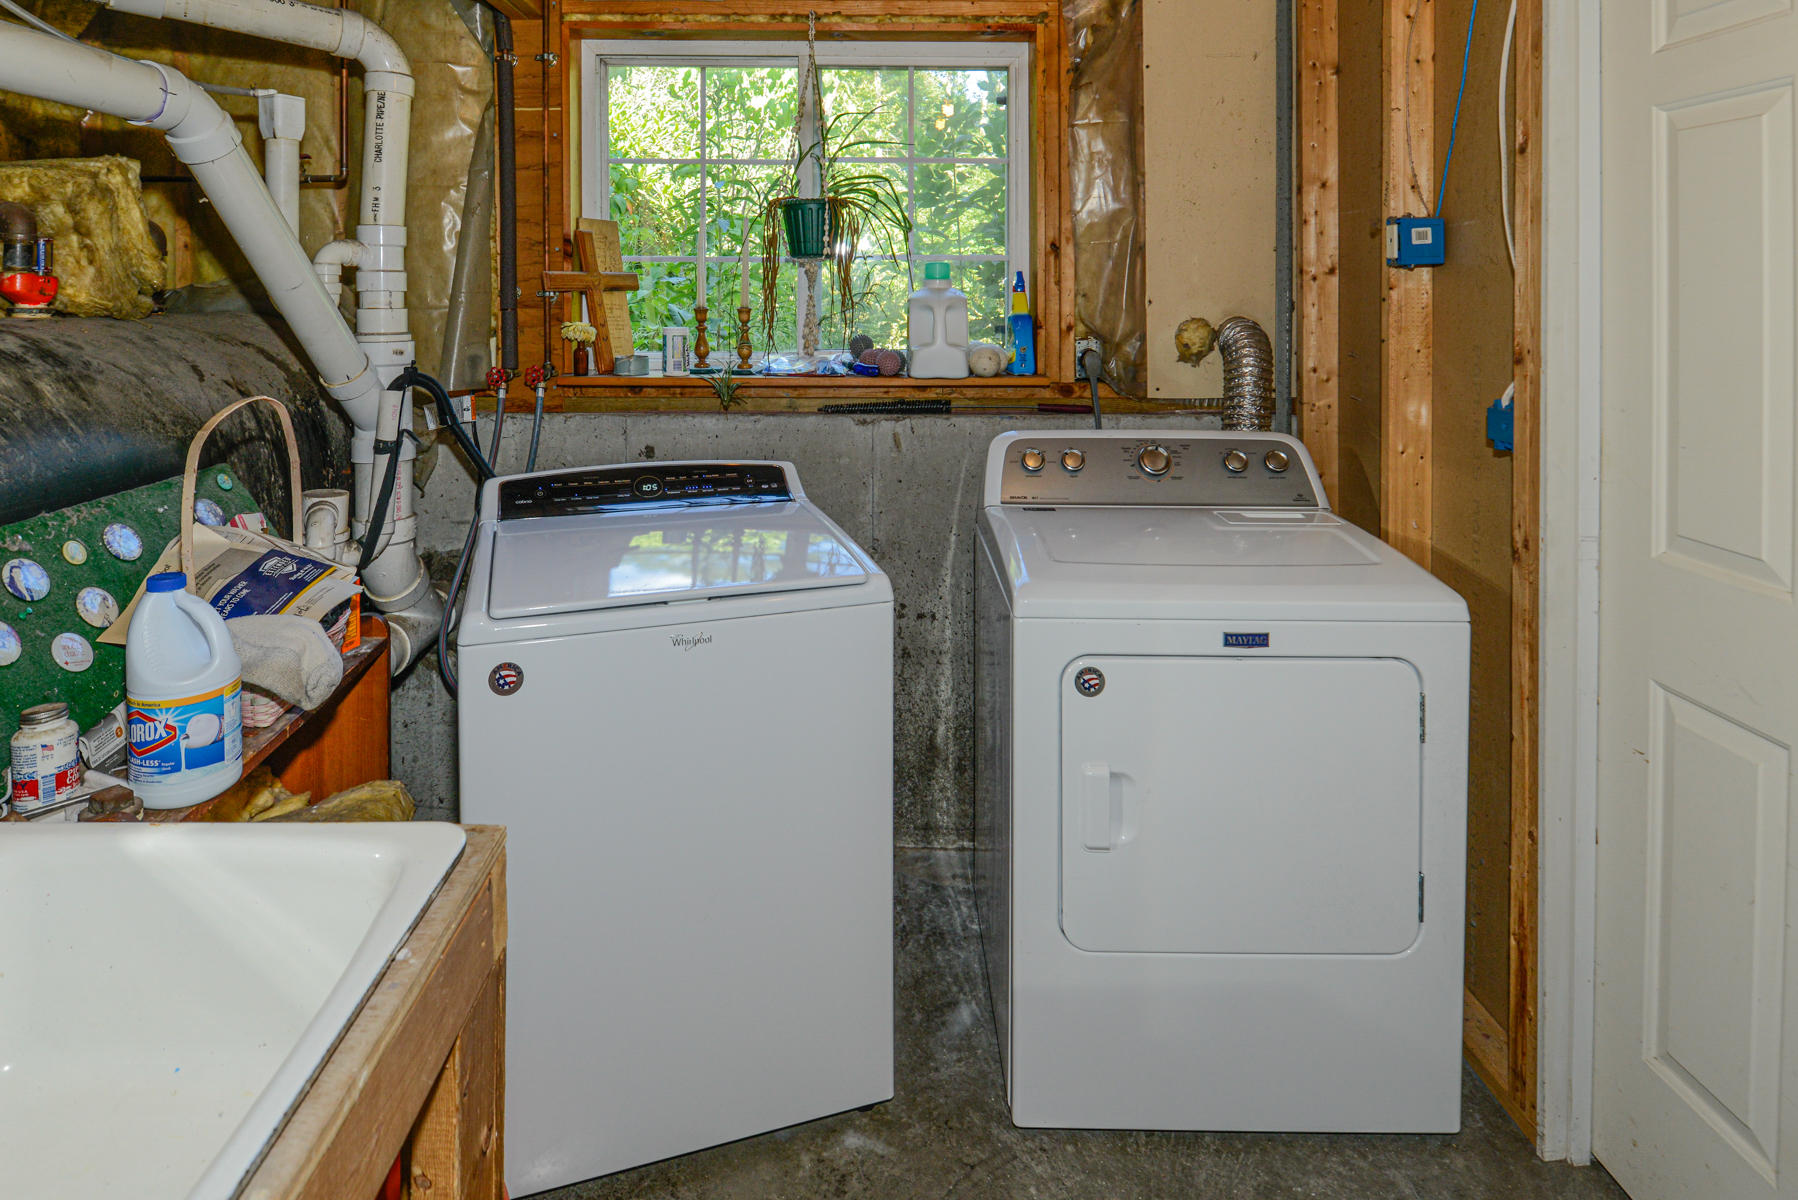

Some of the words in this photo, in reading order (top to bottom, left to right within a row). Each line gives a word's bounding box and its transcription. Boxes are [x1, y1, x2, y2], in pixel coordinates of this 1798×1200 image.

[373, 122, 384, 163] CHARLOTTE
[671, 633, 712, 649] Whirlpool
[1226, 635, 1267, 645] MAYTAG
